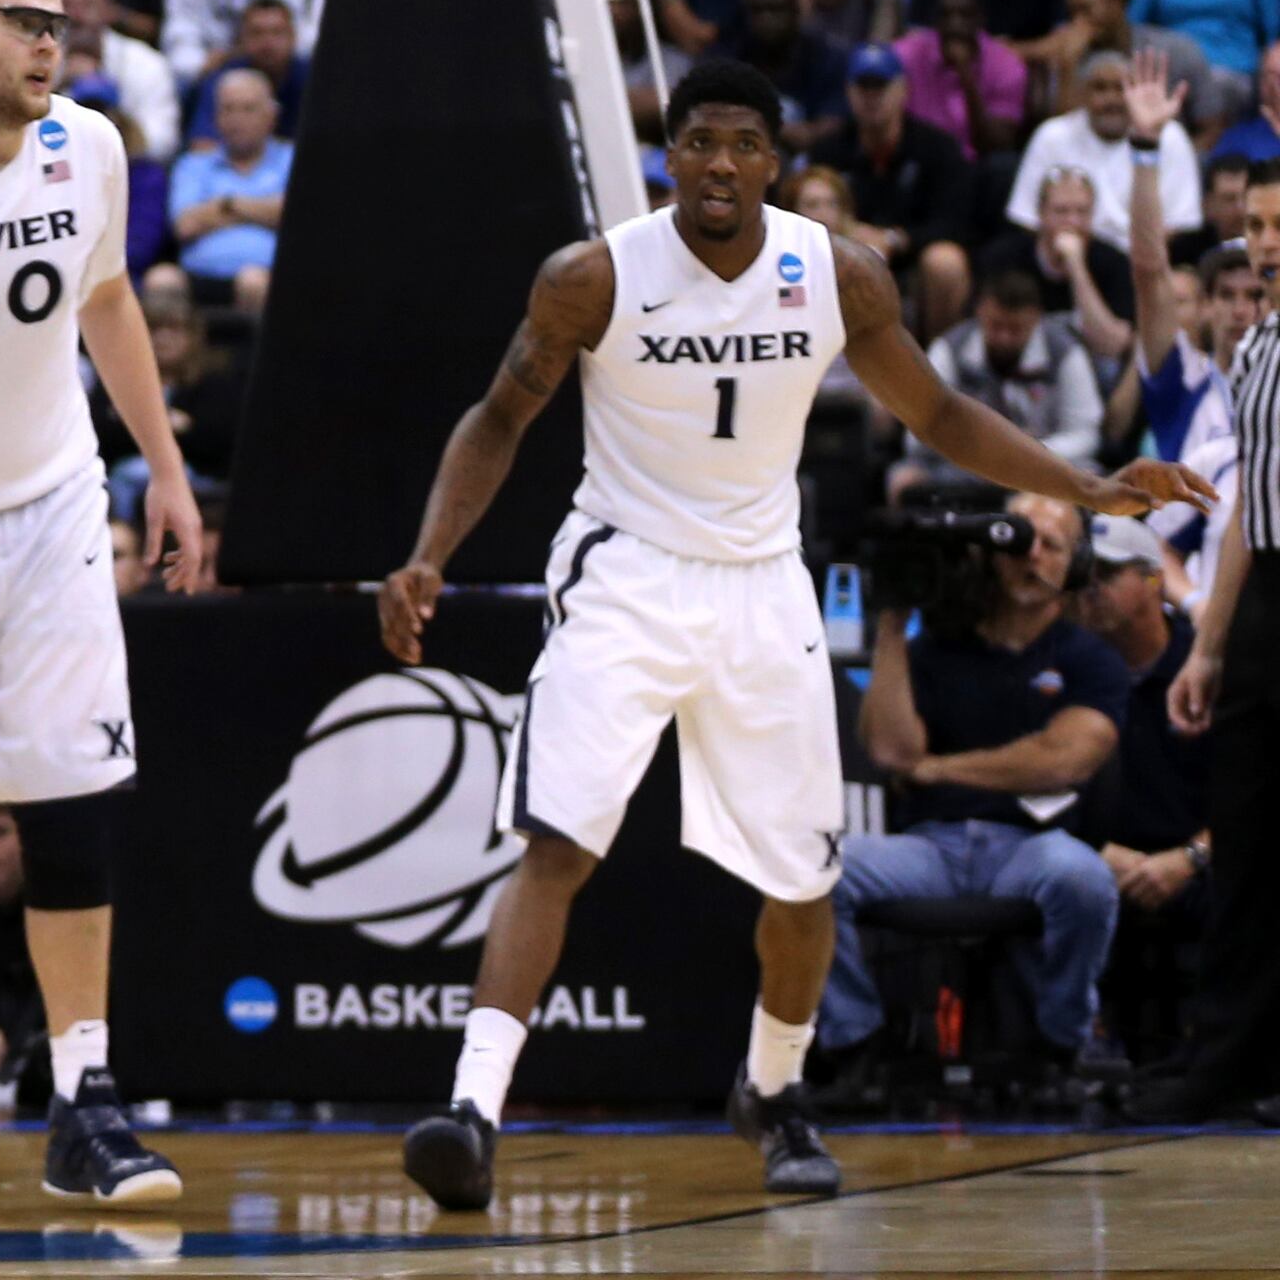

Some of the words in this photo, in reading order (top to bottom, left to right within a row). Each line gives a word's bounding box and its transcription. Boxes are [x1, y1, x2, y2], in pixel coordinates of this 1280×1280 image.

[636, 330, 811, 363] XAVIER
[710, 376, 736, 439] 1
[92, 719, 130, 761] X
[293, 983, 646, 1029] BASKEALL
